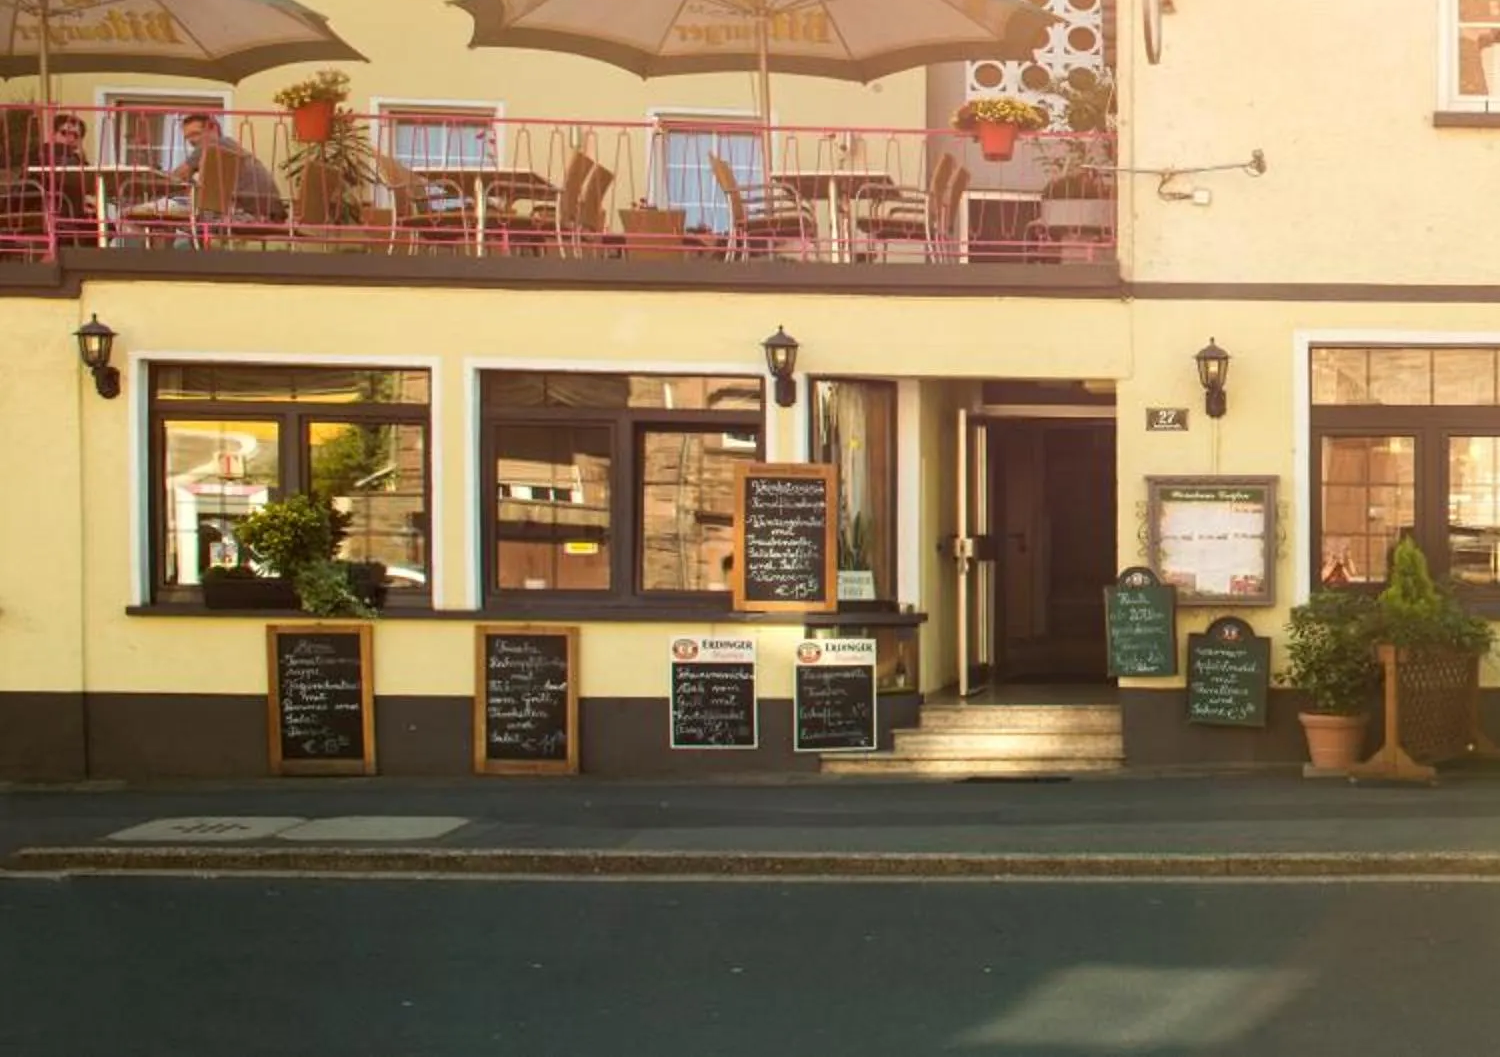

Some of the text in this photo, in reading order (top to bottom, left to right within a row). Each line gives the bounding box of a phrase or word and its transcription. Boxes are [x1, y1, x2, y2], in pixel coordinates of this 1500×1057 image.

[1158, 410, 1177, 424] 27
[702, 639, 753, 650] ERDINGER
[825, 643, 873, 653] ERDINGER
